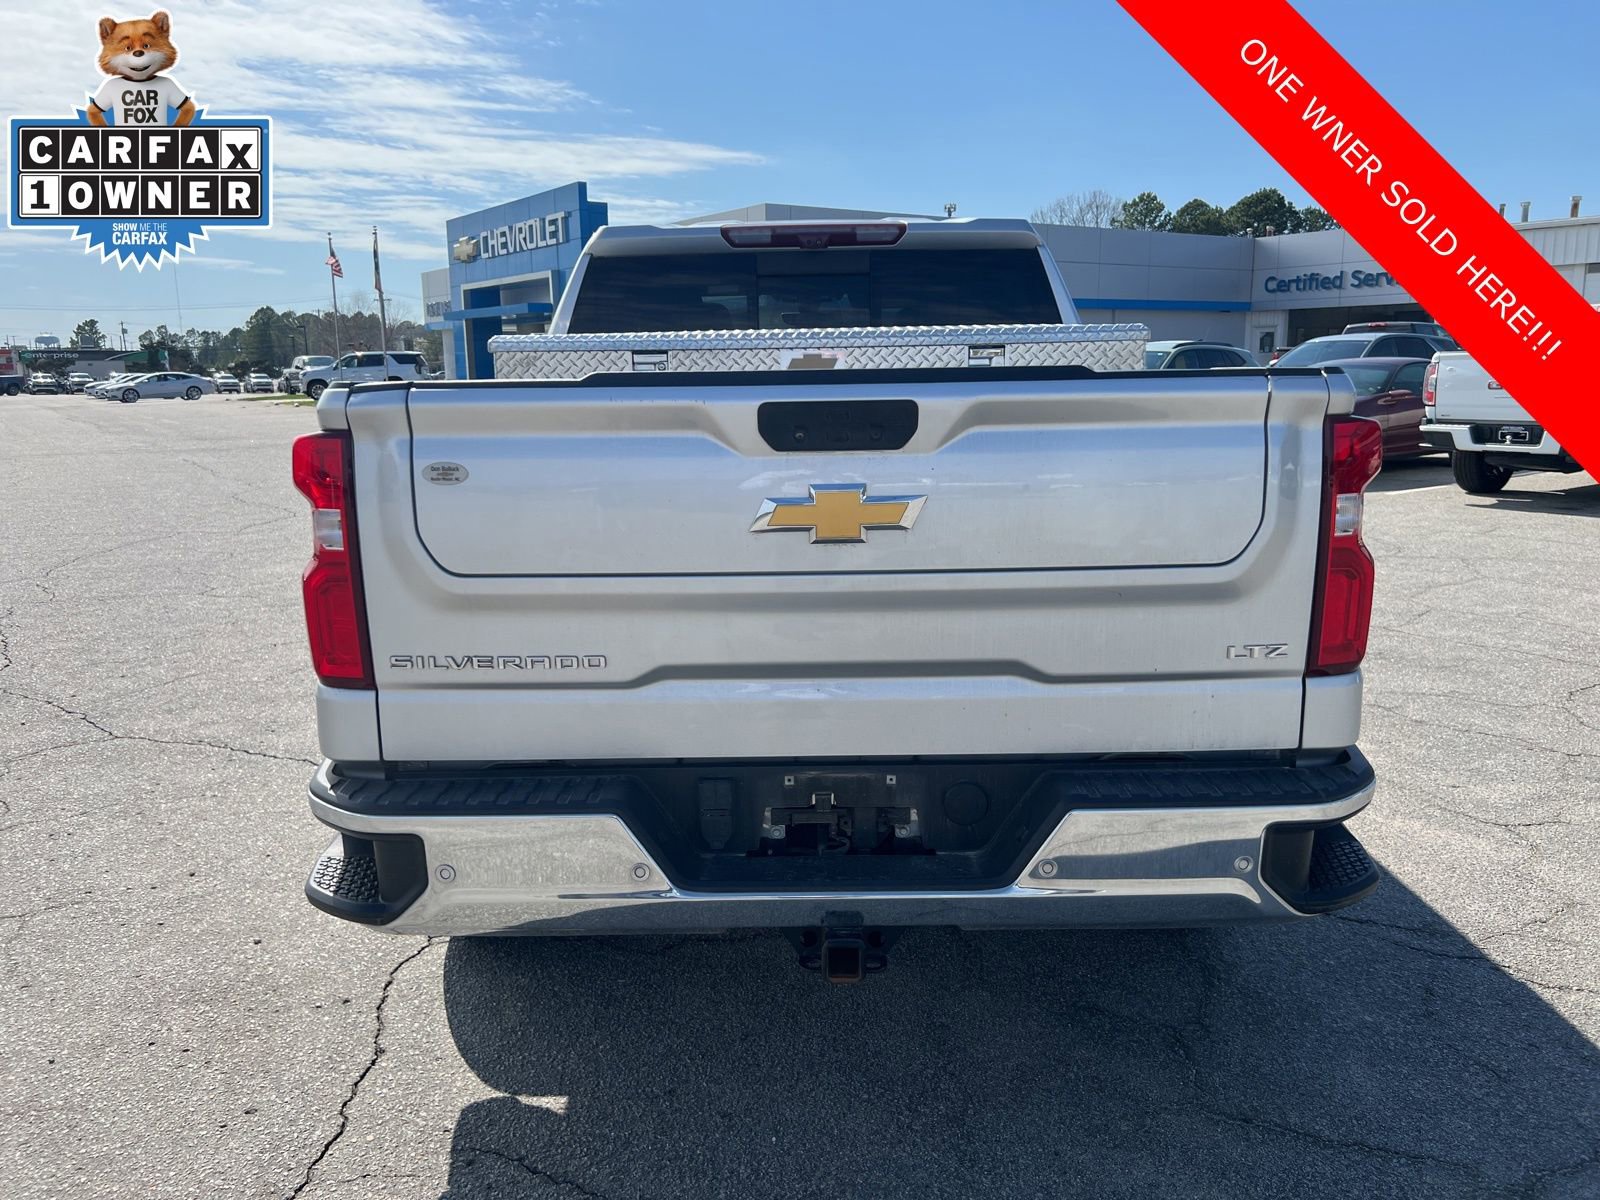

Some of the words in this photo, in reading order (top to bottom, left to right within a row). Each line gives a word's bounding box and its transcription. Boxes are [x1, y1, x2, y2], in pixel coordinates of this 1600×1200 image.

[479, 211, 569, 259] CHEVROLET
[1264, 271, 1344, 293] Certified
[1350, 270, 1399, 288] Serv
[1226, 643, 1289, 660] LTZ
[389, 655, 608, 671] SILVERADO
